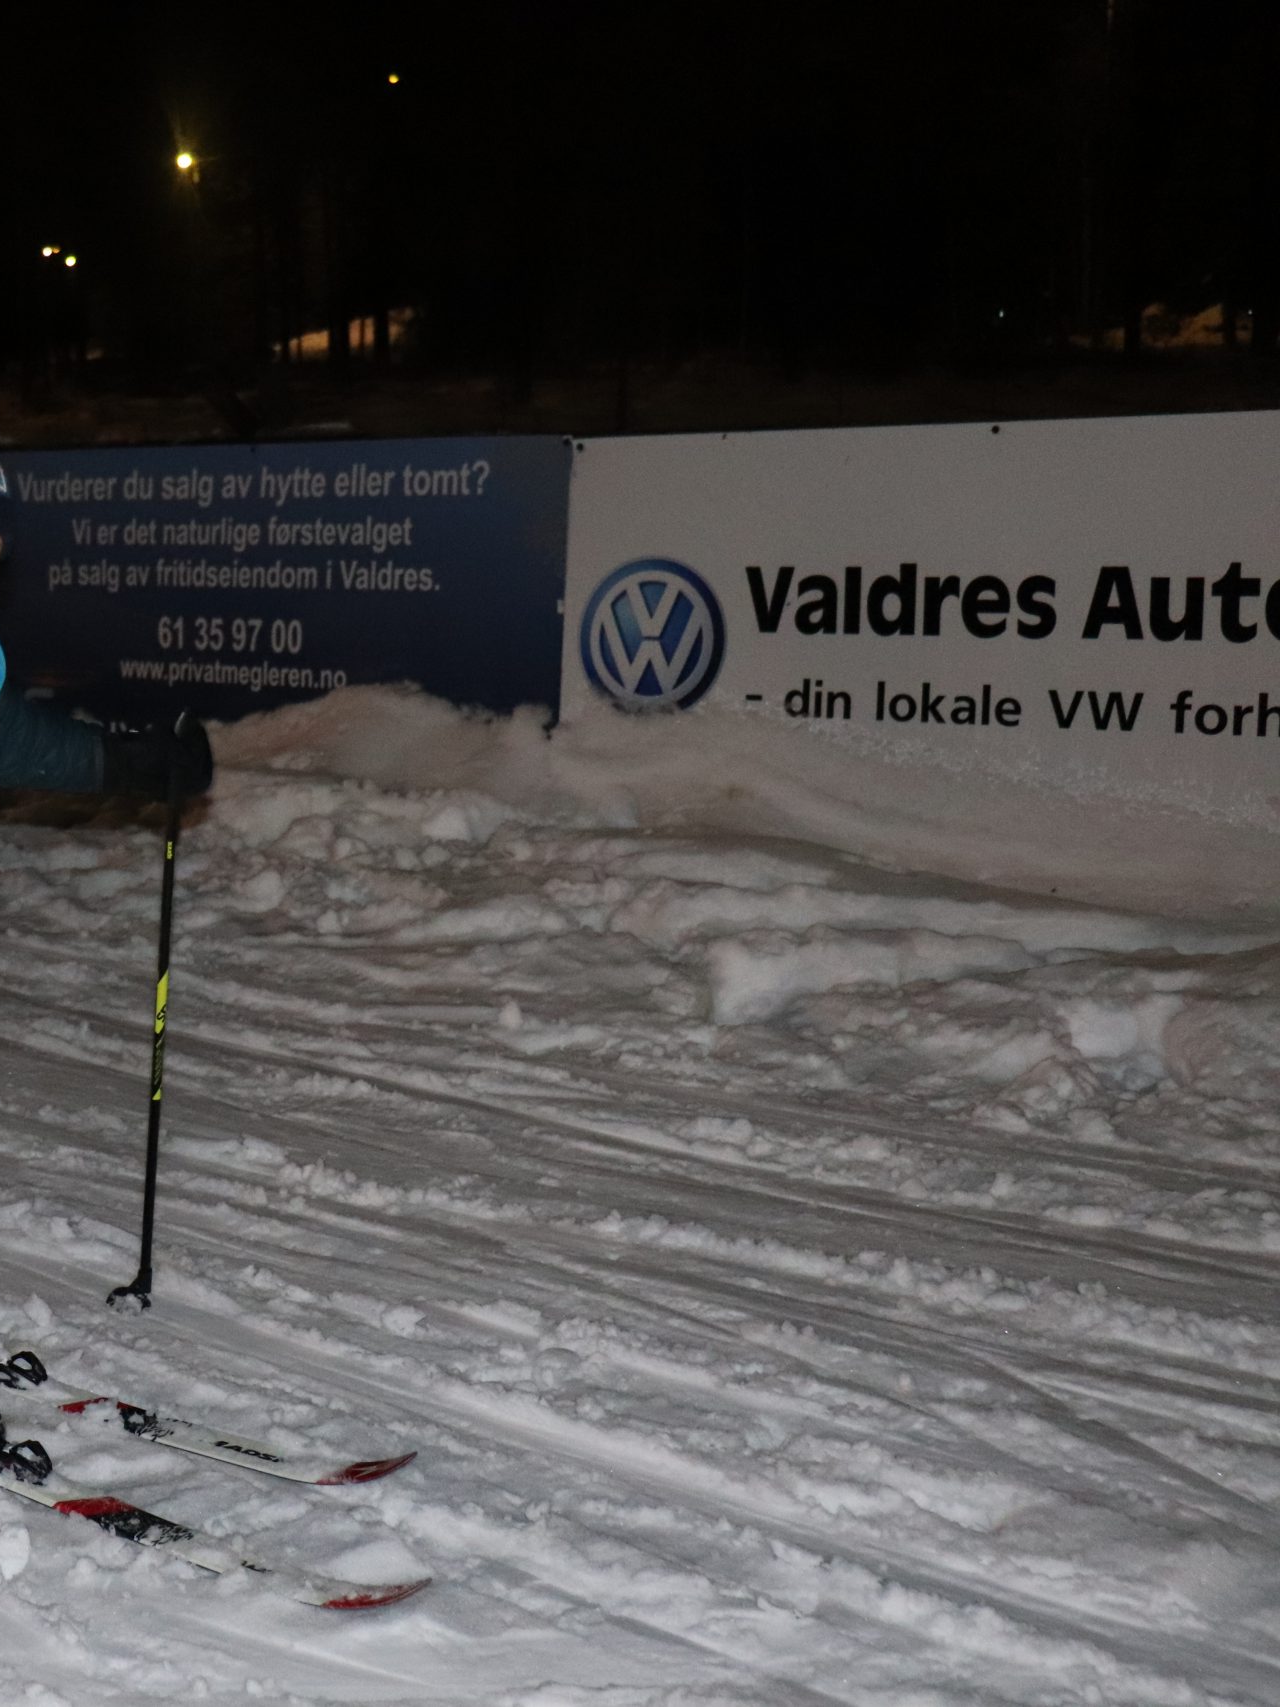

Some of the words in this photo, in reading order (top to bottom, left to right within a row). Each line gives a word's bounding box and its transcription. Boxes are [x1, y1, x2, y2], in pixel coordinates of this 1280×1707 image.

[17, 471, 117, 502] Vurderer
[123, 469, 154, 501] du
[161, 467, 214, 507] salg
[221, 473, 252, 499] av
[260, 465, 326, 507] hytte
[334, 463, 396, 497] eller
[403, 460, 490, 496] tomt?
[72, 519, 91, 544] Vi
[96, 524, 118, 544] er
[123, 518, 156, 544] det
[163, 517, 260, 552] naturlige
[268, 515, 412, 553] førstevalget
[49, 559, 72, 590] på
[78, 559, 120, 592] salg
[126, 564, 150, 586] av
[156, 559, 318, 589] fritidseiendom
[326, 560, 333, 589] i
[339, 560, 440, 591] Valdres.
[745, 563, 1057, 639] Valdres
[157, 616, 184, 649] 61
[195, 617, 223, 650] 35
[232, 618, 263, 652] 97
[271, 619, 303, 654] 00
[119, 657, 347, 692] www.privatmegleren.no
[785, 679, 852, 720] din
[875, 681, 1022, 727] lokale
[1047, 689, 1145, 732] VW
